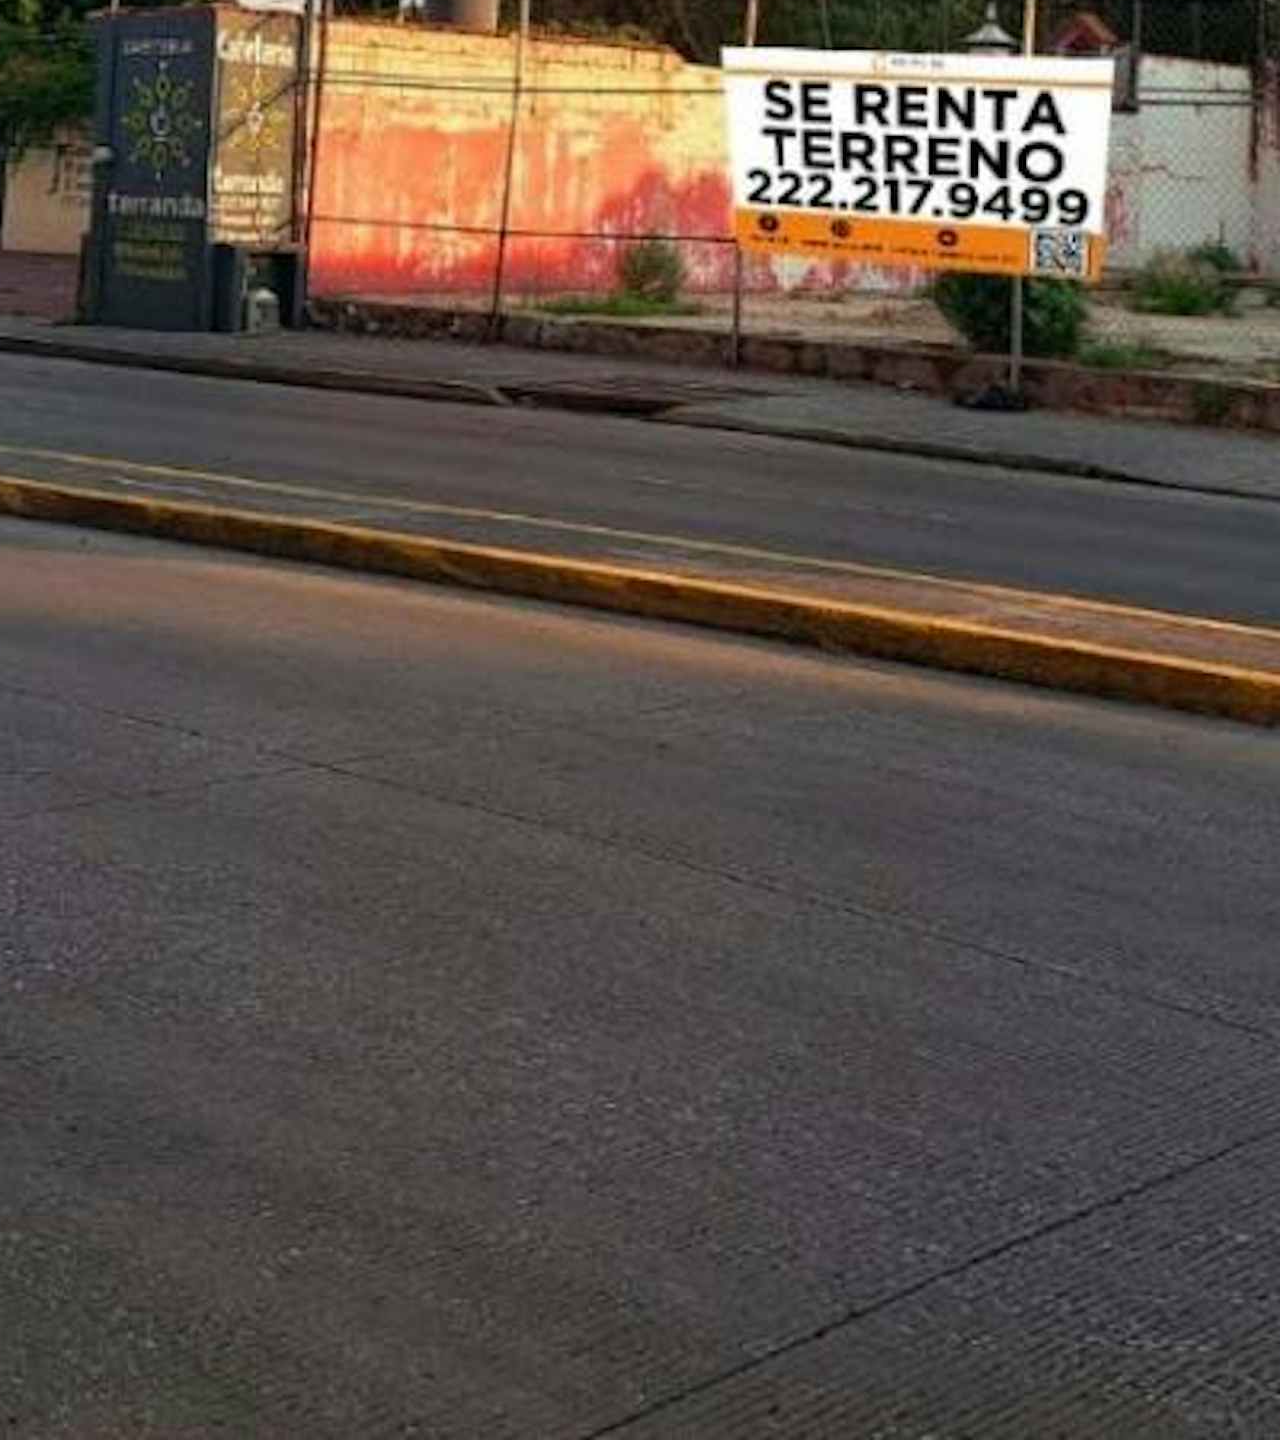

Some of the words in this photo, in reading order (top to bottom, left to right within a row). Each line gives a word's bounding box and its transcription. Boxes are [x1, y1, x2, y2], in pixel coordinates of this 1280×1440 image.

[765, 80, 832, 122] SE
[854, 84, 1066, 135] RENTA
[762, 127, 1064, 182] TERRENO
[747, 169, 1089, 225] 222.217.9499
